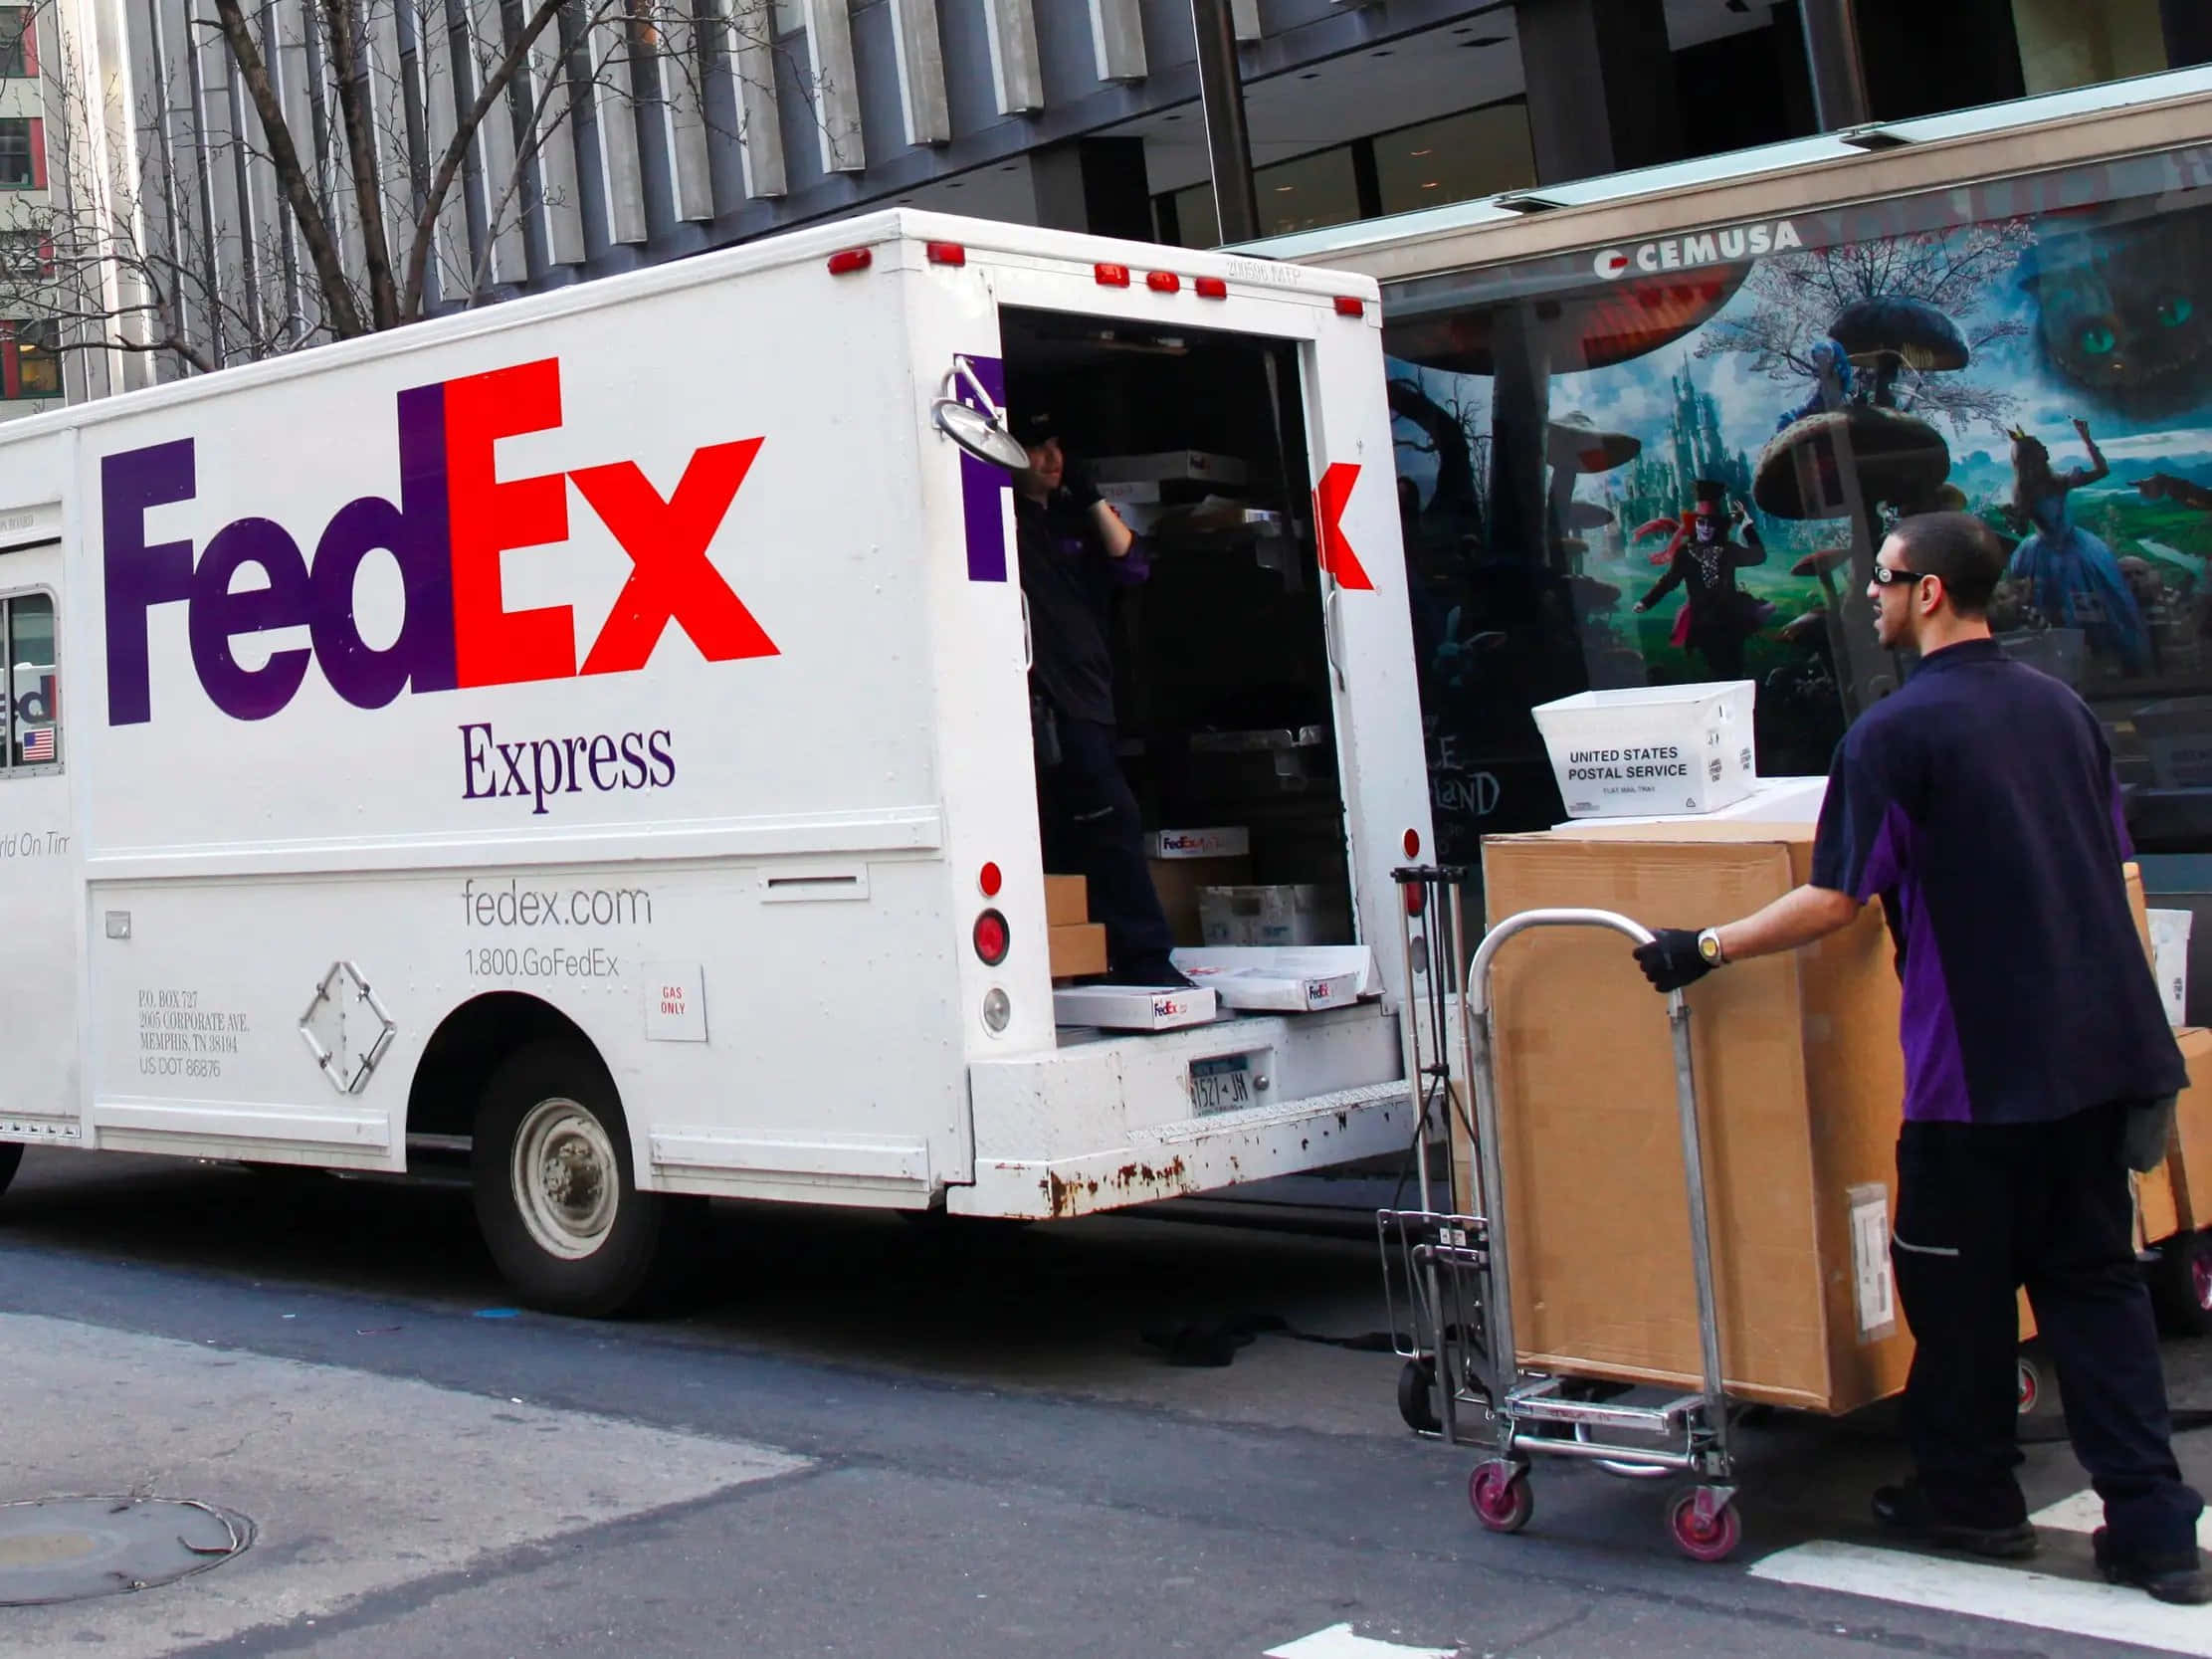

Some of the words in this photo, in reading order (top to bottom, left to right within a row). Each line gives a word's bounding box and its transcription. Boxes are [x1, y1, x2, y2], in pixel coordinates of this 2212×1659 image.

[1636, 220, 1802, 271] CEMUSA
[101, 356, 781, 726] FedEx
[1570, 749, 1619, 763] UNITED
[1623, 746, 1678, 761] STATES
[458, 724, 676, 814] Express
[1568, 766, 1622, 780] POSTAL
[1626, 763, 1688, 778] SERVICE
[20, 832, 41, 857] On
[462, 879, 653, 927] fedex.com
[465, 947, 620, 977] 1.800.GoFedEx
[159, 989, 179, 1008] BOX
[663, 986, 683, 999] GAS
[661, 1001, 686, 1015] ONLY
[163, 1011, 225, 1031] CORPORATE
[193, 1033, 207, 1052] TN
[139, 1056, 156, 1075] US
[159, 1057, 183, 1075] DOT
